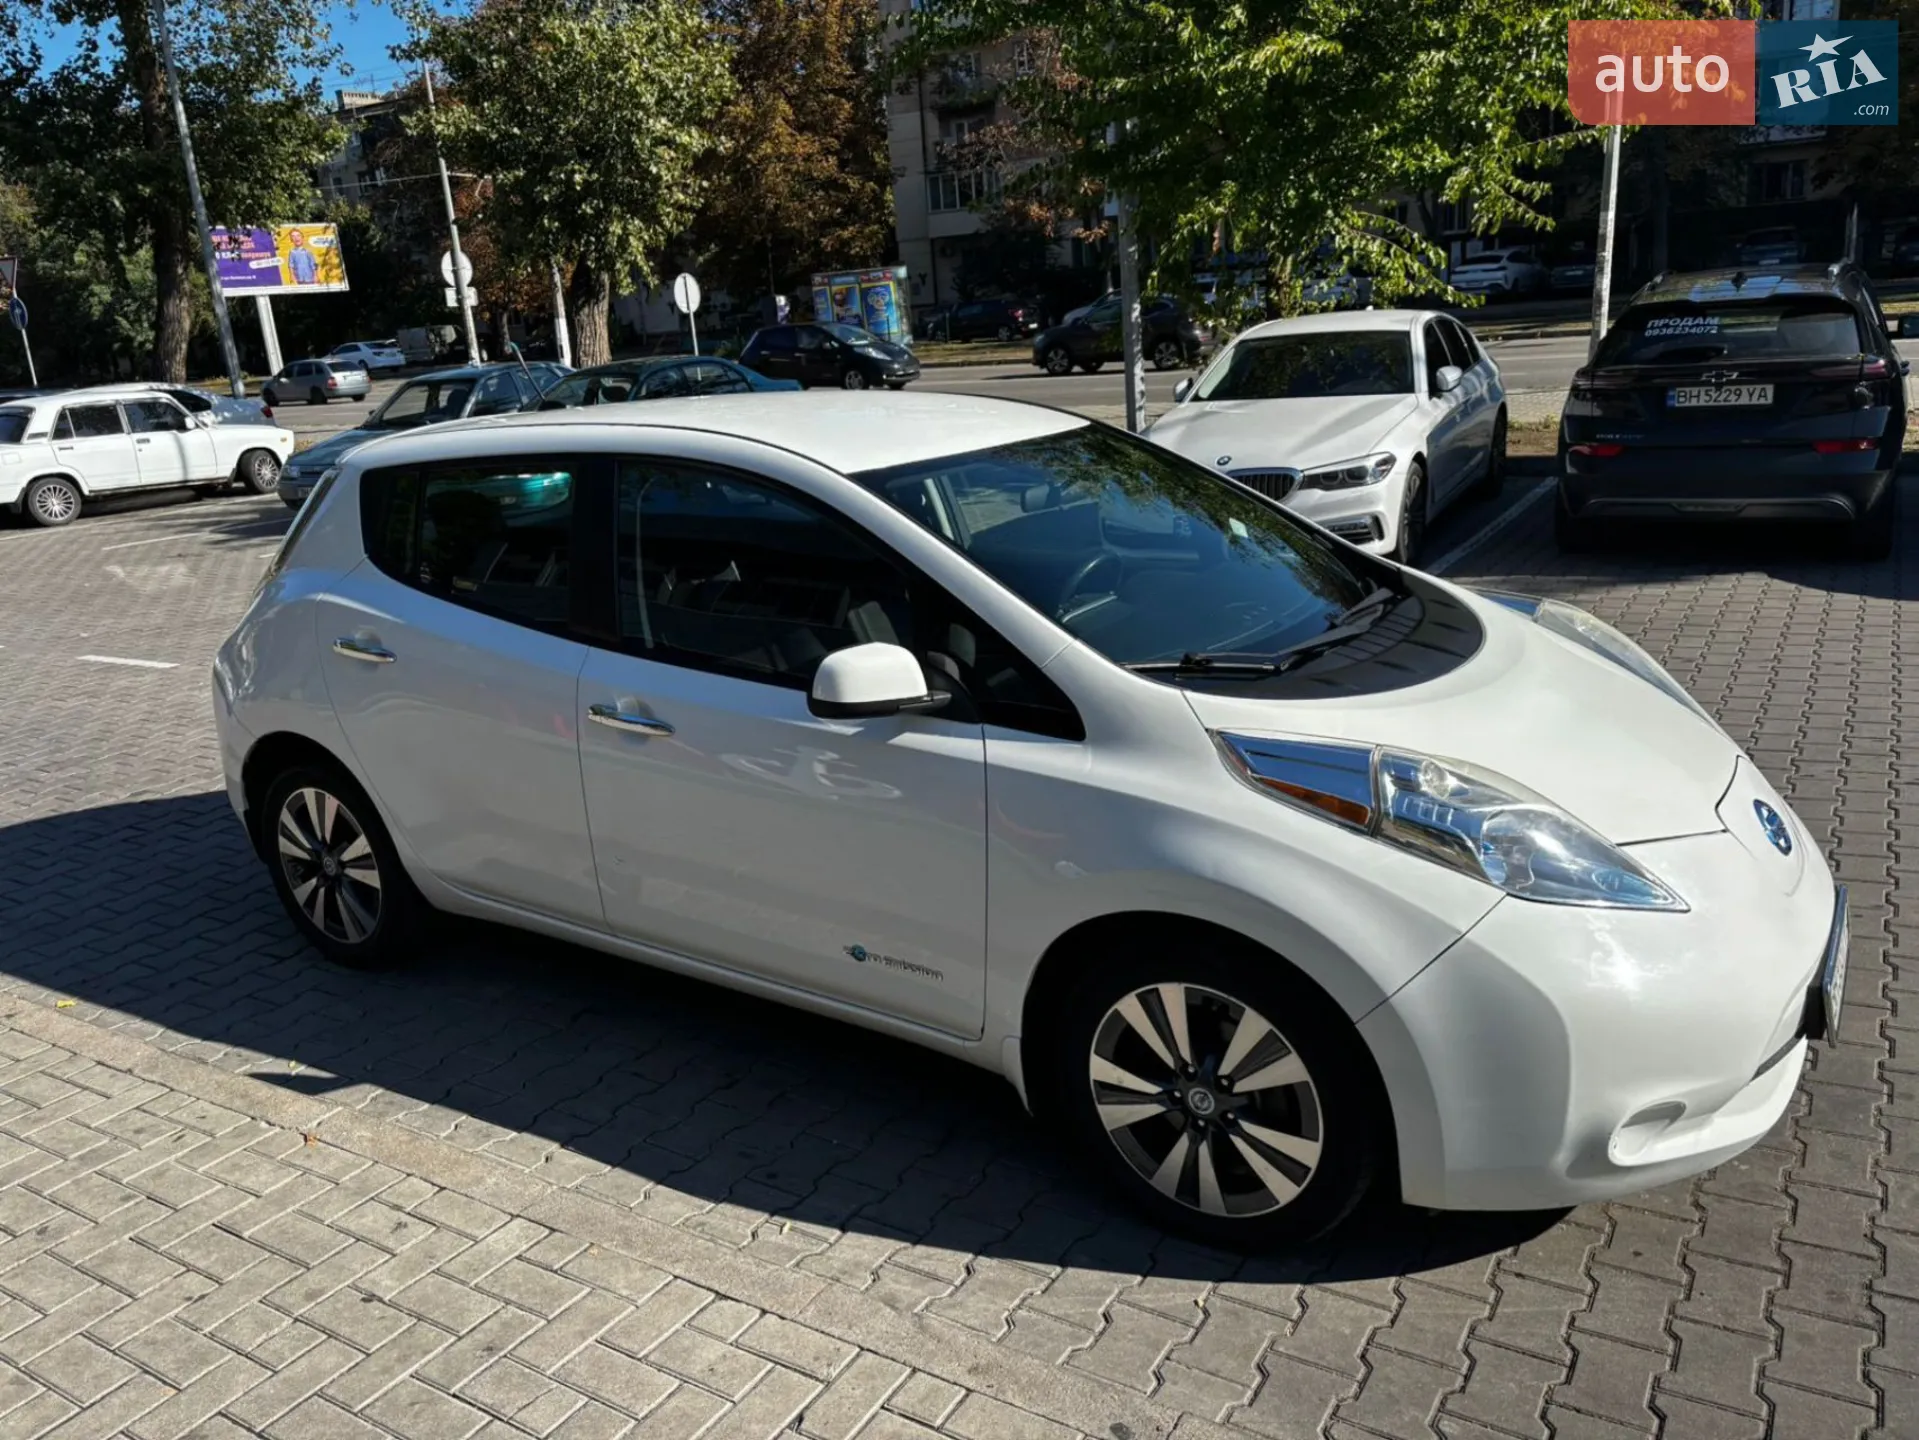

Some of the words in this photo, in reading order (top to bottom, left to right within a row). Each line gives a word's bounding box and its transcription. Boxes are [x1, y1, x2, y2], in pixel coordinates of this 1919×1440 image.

[1646, 316, 1720, 328] ПРОДАМ
[1677, 389, 1701, 404] BH
[1703, 387, 1743, 404] 5229
[1746, 386, 1768, 402] YA
